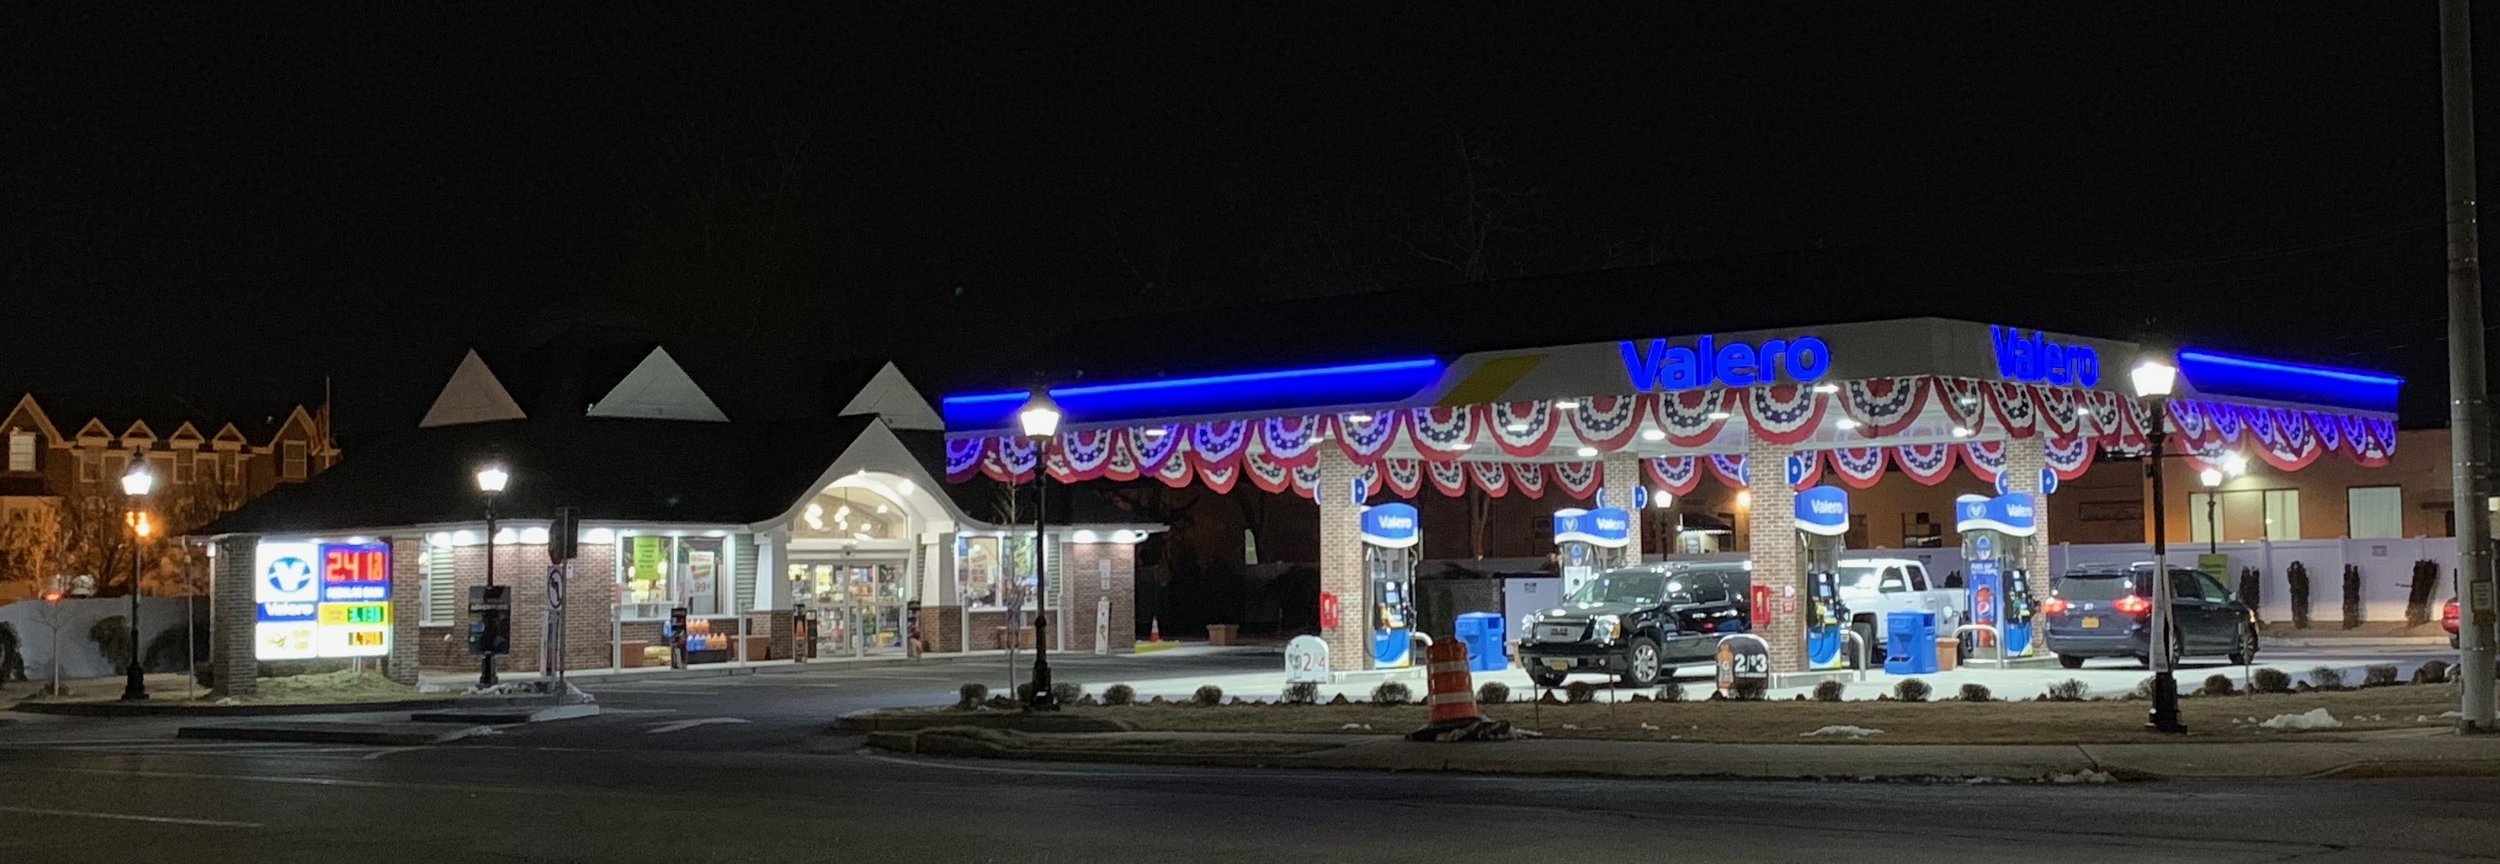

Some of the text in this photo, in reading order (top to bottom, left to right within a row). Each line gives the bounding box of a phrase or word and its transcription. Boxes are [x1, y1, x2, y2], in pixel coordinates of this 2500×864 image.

[1990, 323, 2100, 388] Valero
[1619, 335, 1830, 392] Valero
[1811, 499, 1843, 514] Valero
[2006, 503, 2033, 518] Valero
[1378, 515, 1413, 529] Valero
[1596, 517, 1625, 530] Valero
